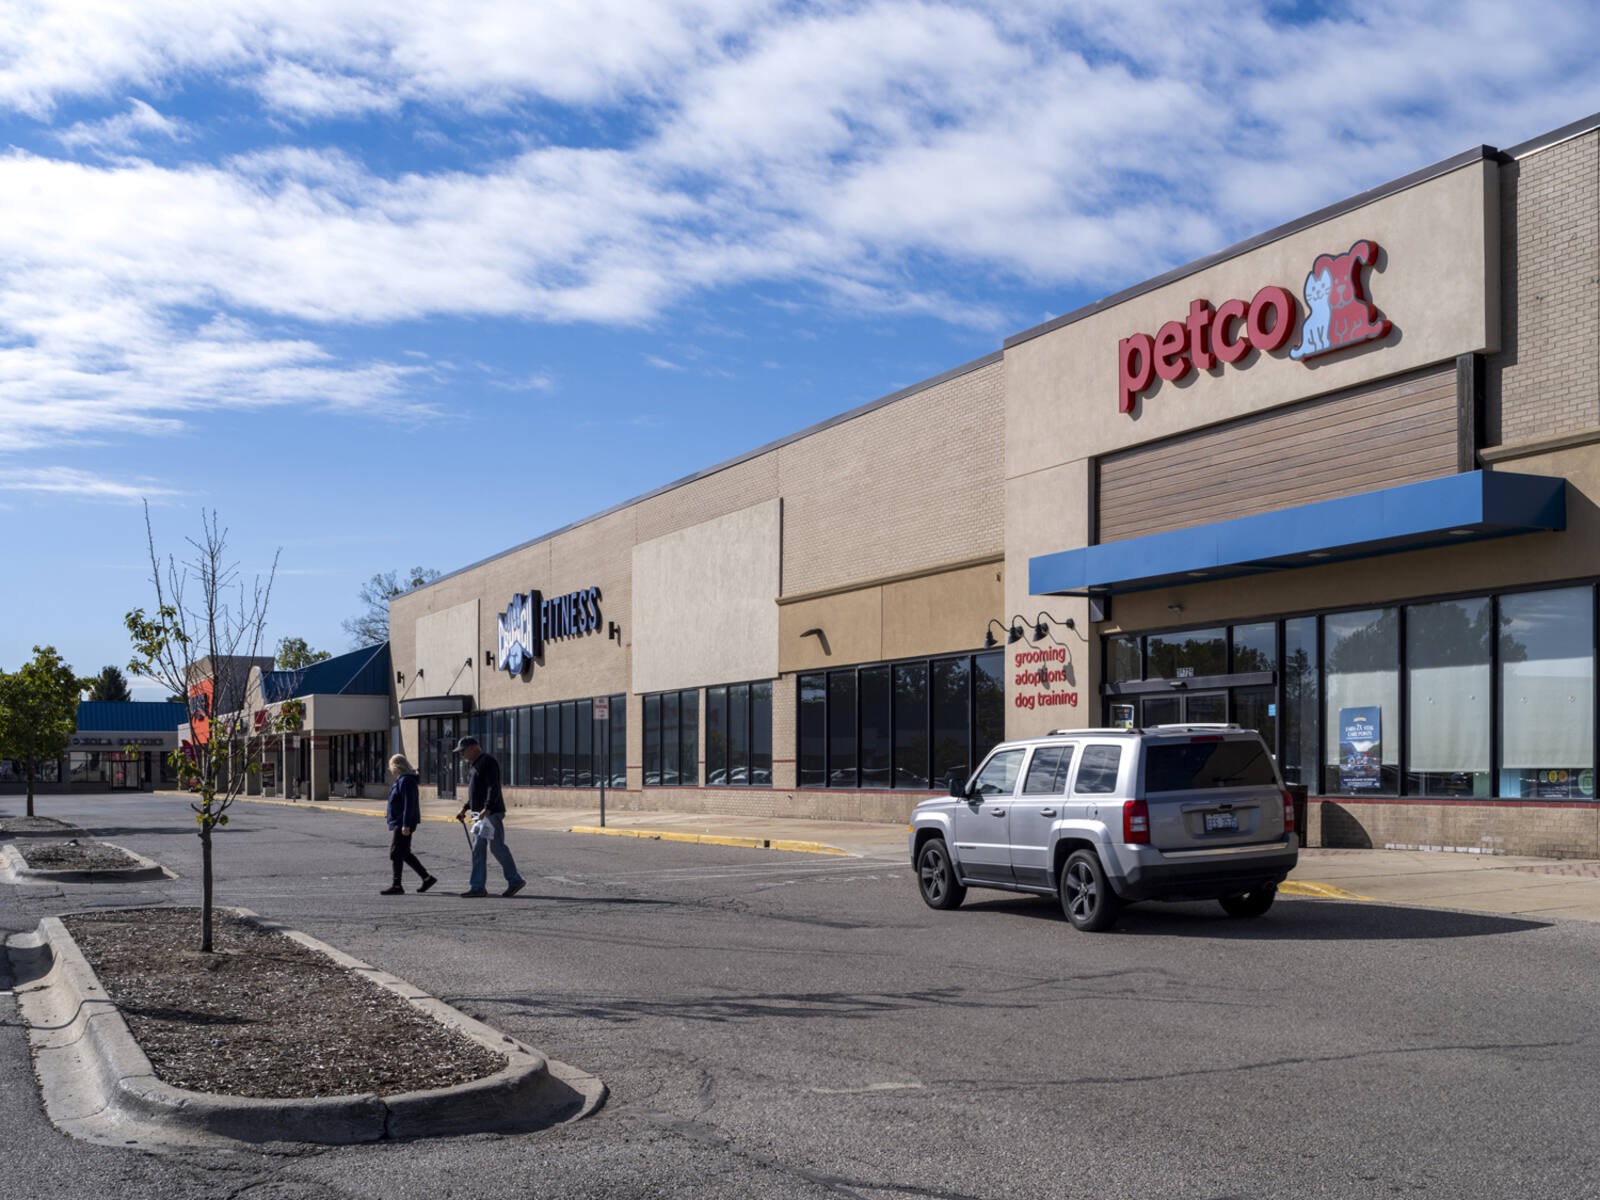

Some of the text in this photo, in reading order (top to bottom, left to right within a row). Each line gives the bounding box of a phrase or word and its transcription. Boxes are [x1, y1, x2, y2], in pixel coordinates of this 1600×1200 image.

[1119, 286, 1295, 414] petco
[541, 586, 601, 641] FITNESS
[1015, 645, 1065, 667] grooming
[1015, 669, 1067, 687] adoptions
[1015, 689, 1078, 710] dog training
